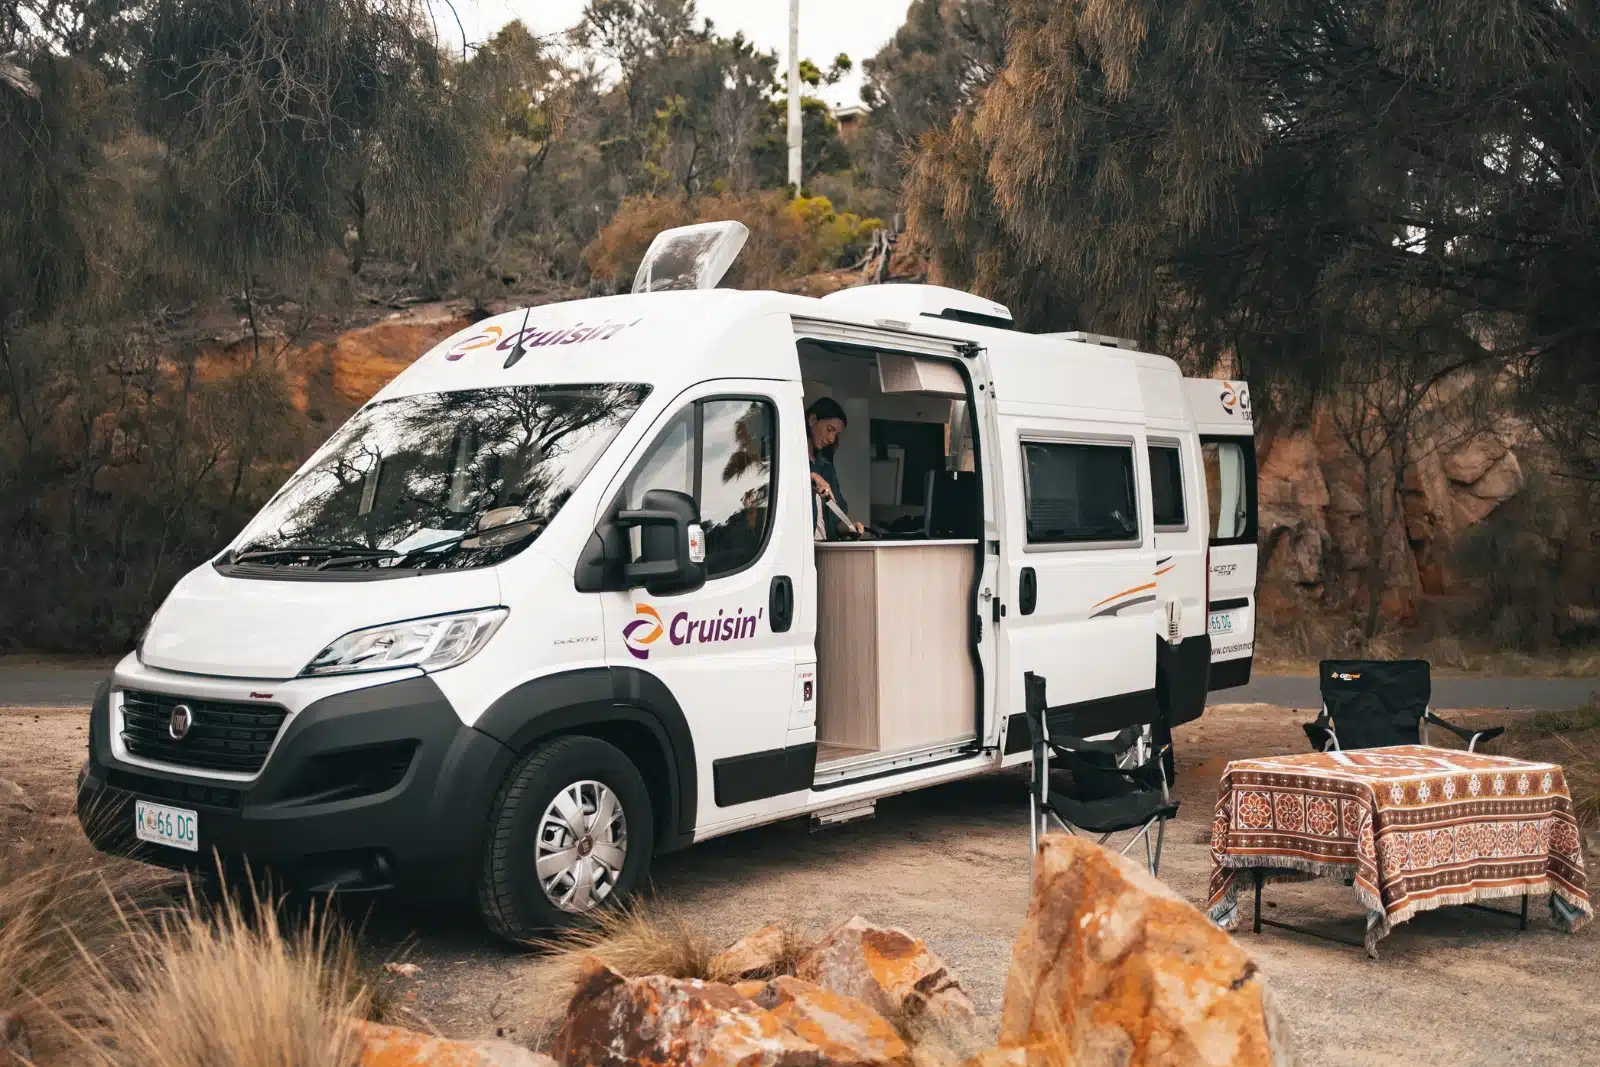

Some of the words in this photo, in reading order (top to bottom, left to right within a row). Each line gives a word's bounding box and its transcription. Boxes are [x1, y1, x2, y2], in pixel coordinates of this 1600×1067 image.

[495, 317, 644, 351] Cruisin'
[669, 607, 763, 646] Cruisin'
[1221, 614, 1232, 629] DG
[249, 691, 274, 699] Power
[137, 805, 146, 831] K
[157, 810, 173, 837] 66
[177, 814, 194, 841] DG
